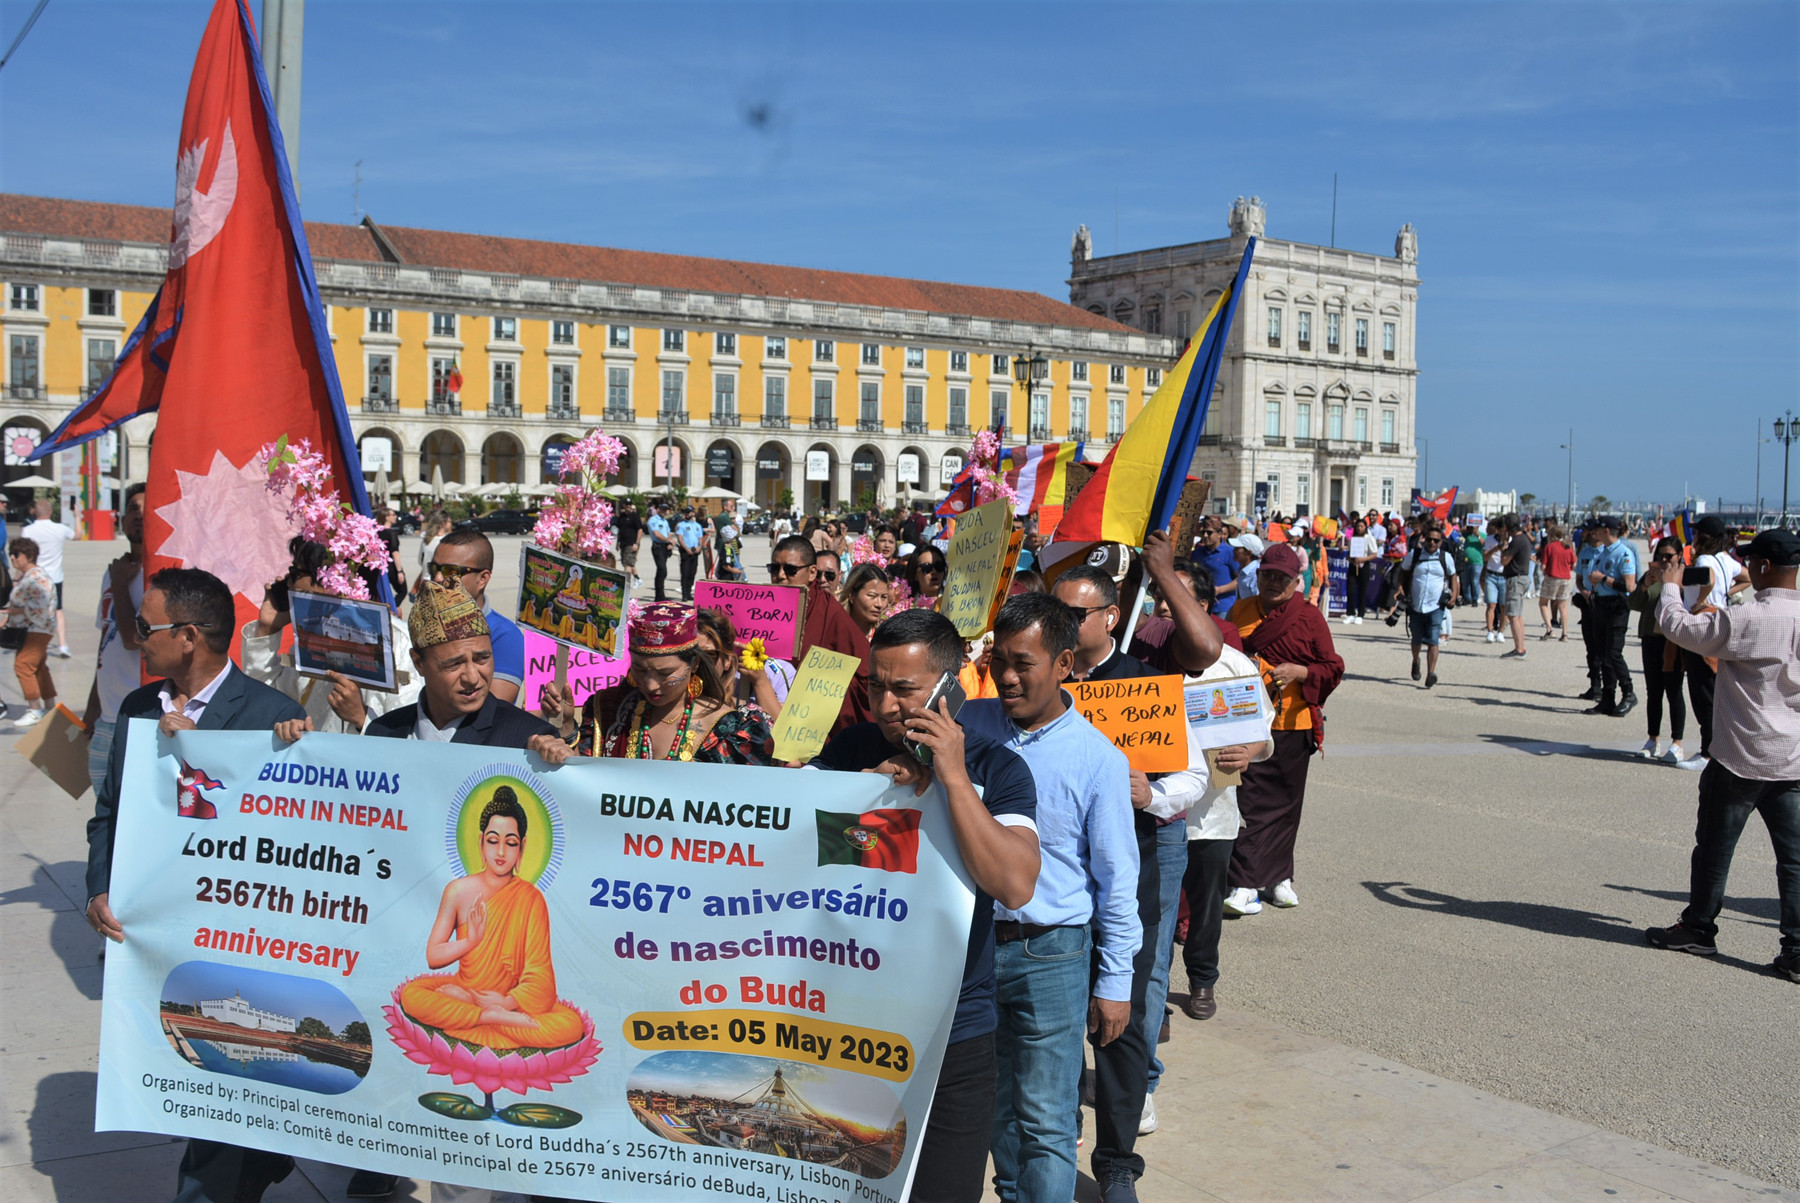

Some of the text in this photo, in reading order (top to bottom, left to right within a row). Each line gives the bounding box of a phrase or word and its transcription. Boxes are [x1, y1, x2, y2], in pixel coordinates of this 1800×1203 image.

[956, 530, 997, 556] NASCEU
[710, 586, 774, 602] BUDDHA
[747, 608, 793, 622] BORN
[808, 650, 842, 671] BUDA
[1076, 682, 1160, 701] BUDDHA
[788, 704, 810, 718] NO
[1083, 704, 1177, 724] AS BORN
[784, 726, 826, 744] NEPAL
[1114, 731, 1174, 748] NEPAL
[258, 762, 400, 794] BUDDHA WAS
[240, 794, 408, 832] BORN IN NEPAL
[600, 793, 792, 831] BUDA NASCEU
[182, 832, 246, 862] Lord
[623, 832, 764, 868] NO NEPAL
[196, 876, 369, 924] 2567th birth
[702, 882, 908, 922] aniversário
[194, 926, 360, 977] anniversary
[614, 929, 882, 972] de nascimento
[679, 975, 826, 1014] do Buda
[632, 1018, 910, 1073] Date: 05 May 2023
[142, 1073, 214, 1096] Organised
[218, 1083, 238, 1102] by:
[243, 1088, 300, 1113] Principal
[304, 1102, 382, 1130] ceremonial
[387, 1119, 469, 1144] committee
[474, 1132, 490, 1146] of
[496, 1134, 533, 1150] Lord
[626, 1142, 686, 1162] 2567th
[692, 1151, 794, 1182] anniversary,
[800, 1165, 850, 1192] Lisbon
[163, 1099, 242, 1124] Organizado
[246, 1114, 279, 1131] pela:
[284, 1120, 332, 1142] Comitê
[337, 1130, 354, 1146] de
[358, 1137, 437, 1161] cerimonial
[442, 1152, 512, 1172] principal
[518, 1158, 538, 1174] de
[601, 1166, 696, 1188] aniversário
[702, 1175, 770, 1202] deBuda,
